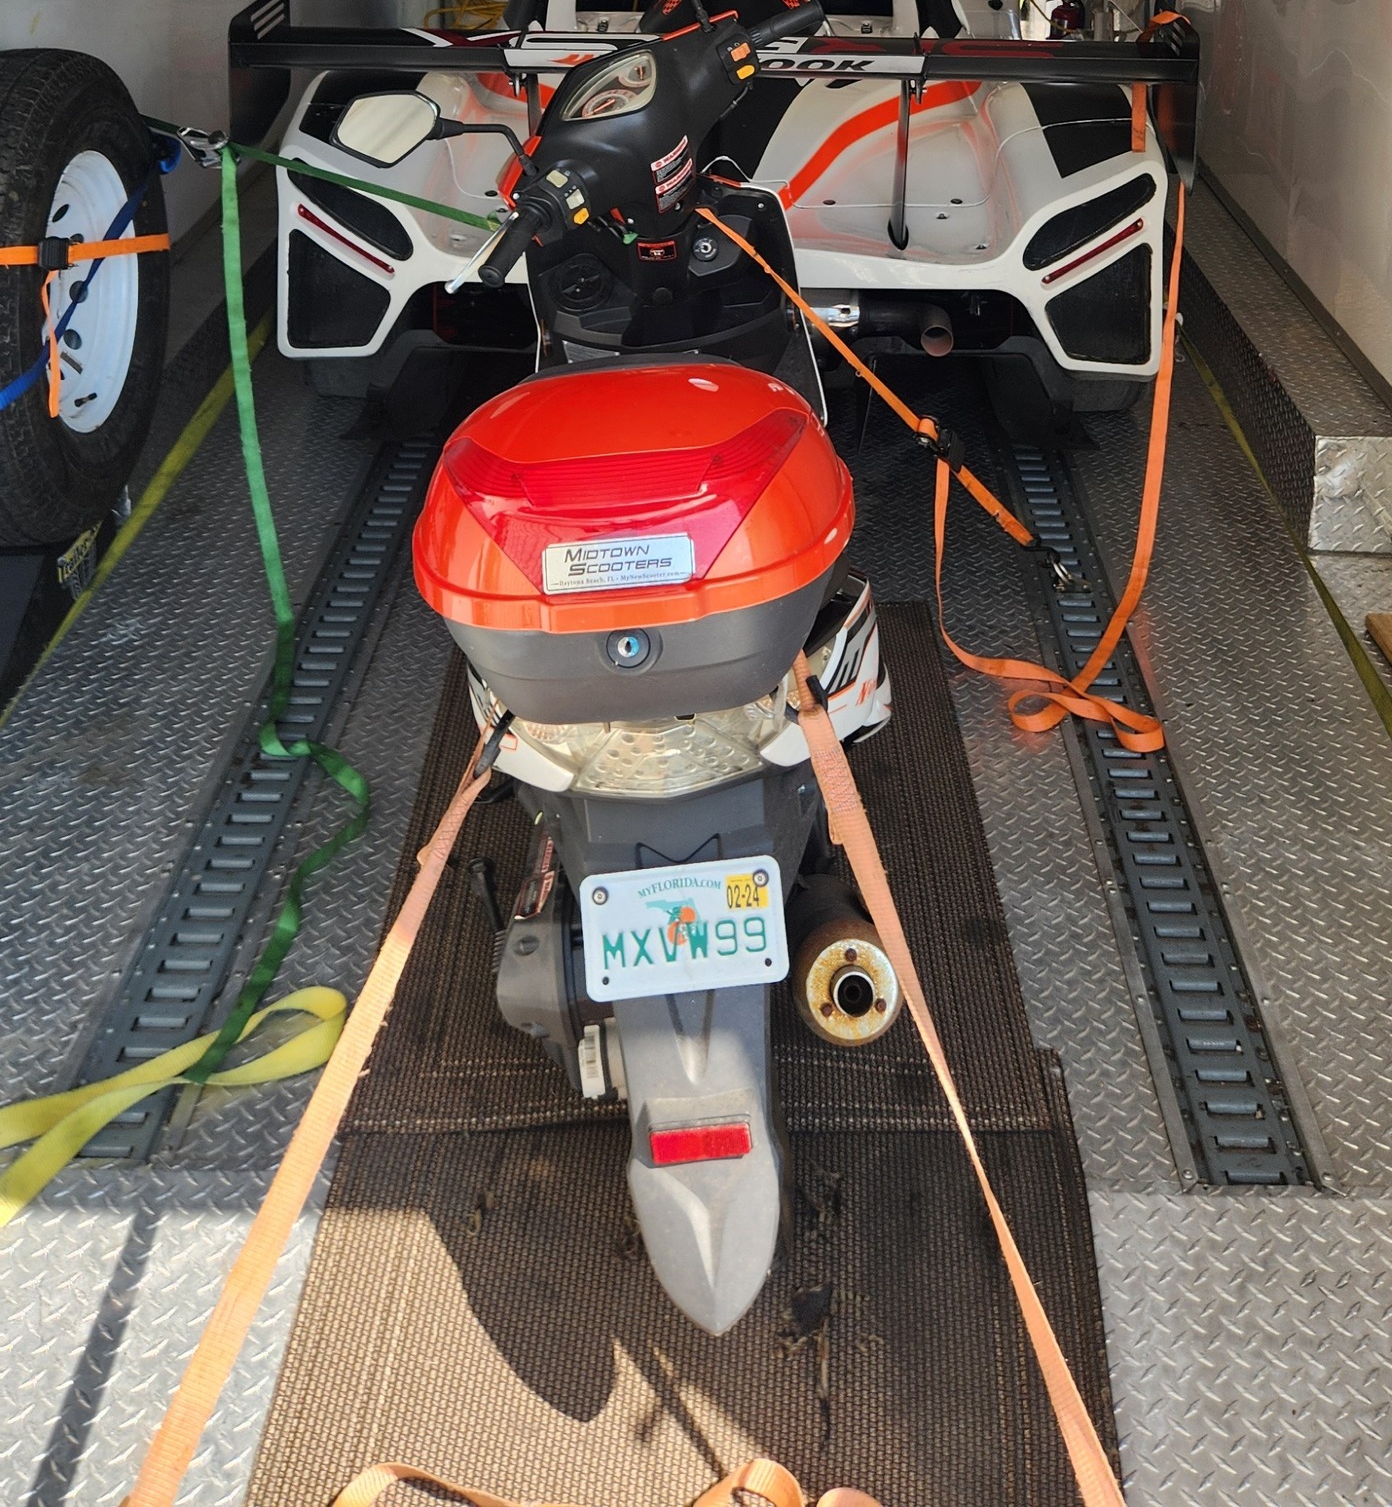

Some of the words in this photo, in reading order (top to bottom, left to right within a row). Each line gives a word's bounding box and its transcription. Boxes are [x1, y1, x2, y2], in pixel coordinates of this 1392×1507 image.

[759, 58, 875, 71] OOK
[564, 545, 650, 563] MIDTOWN
[568, 557, 673, 577] SCOOTERS
[726, 883, 760, 909] 02-24
[602, 916, 767, 970] MXVW99
